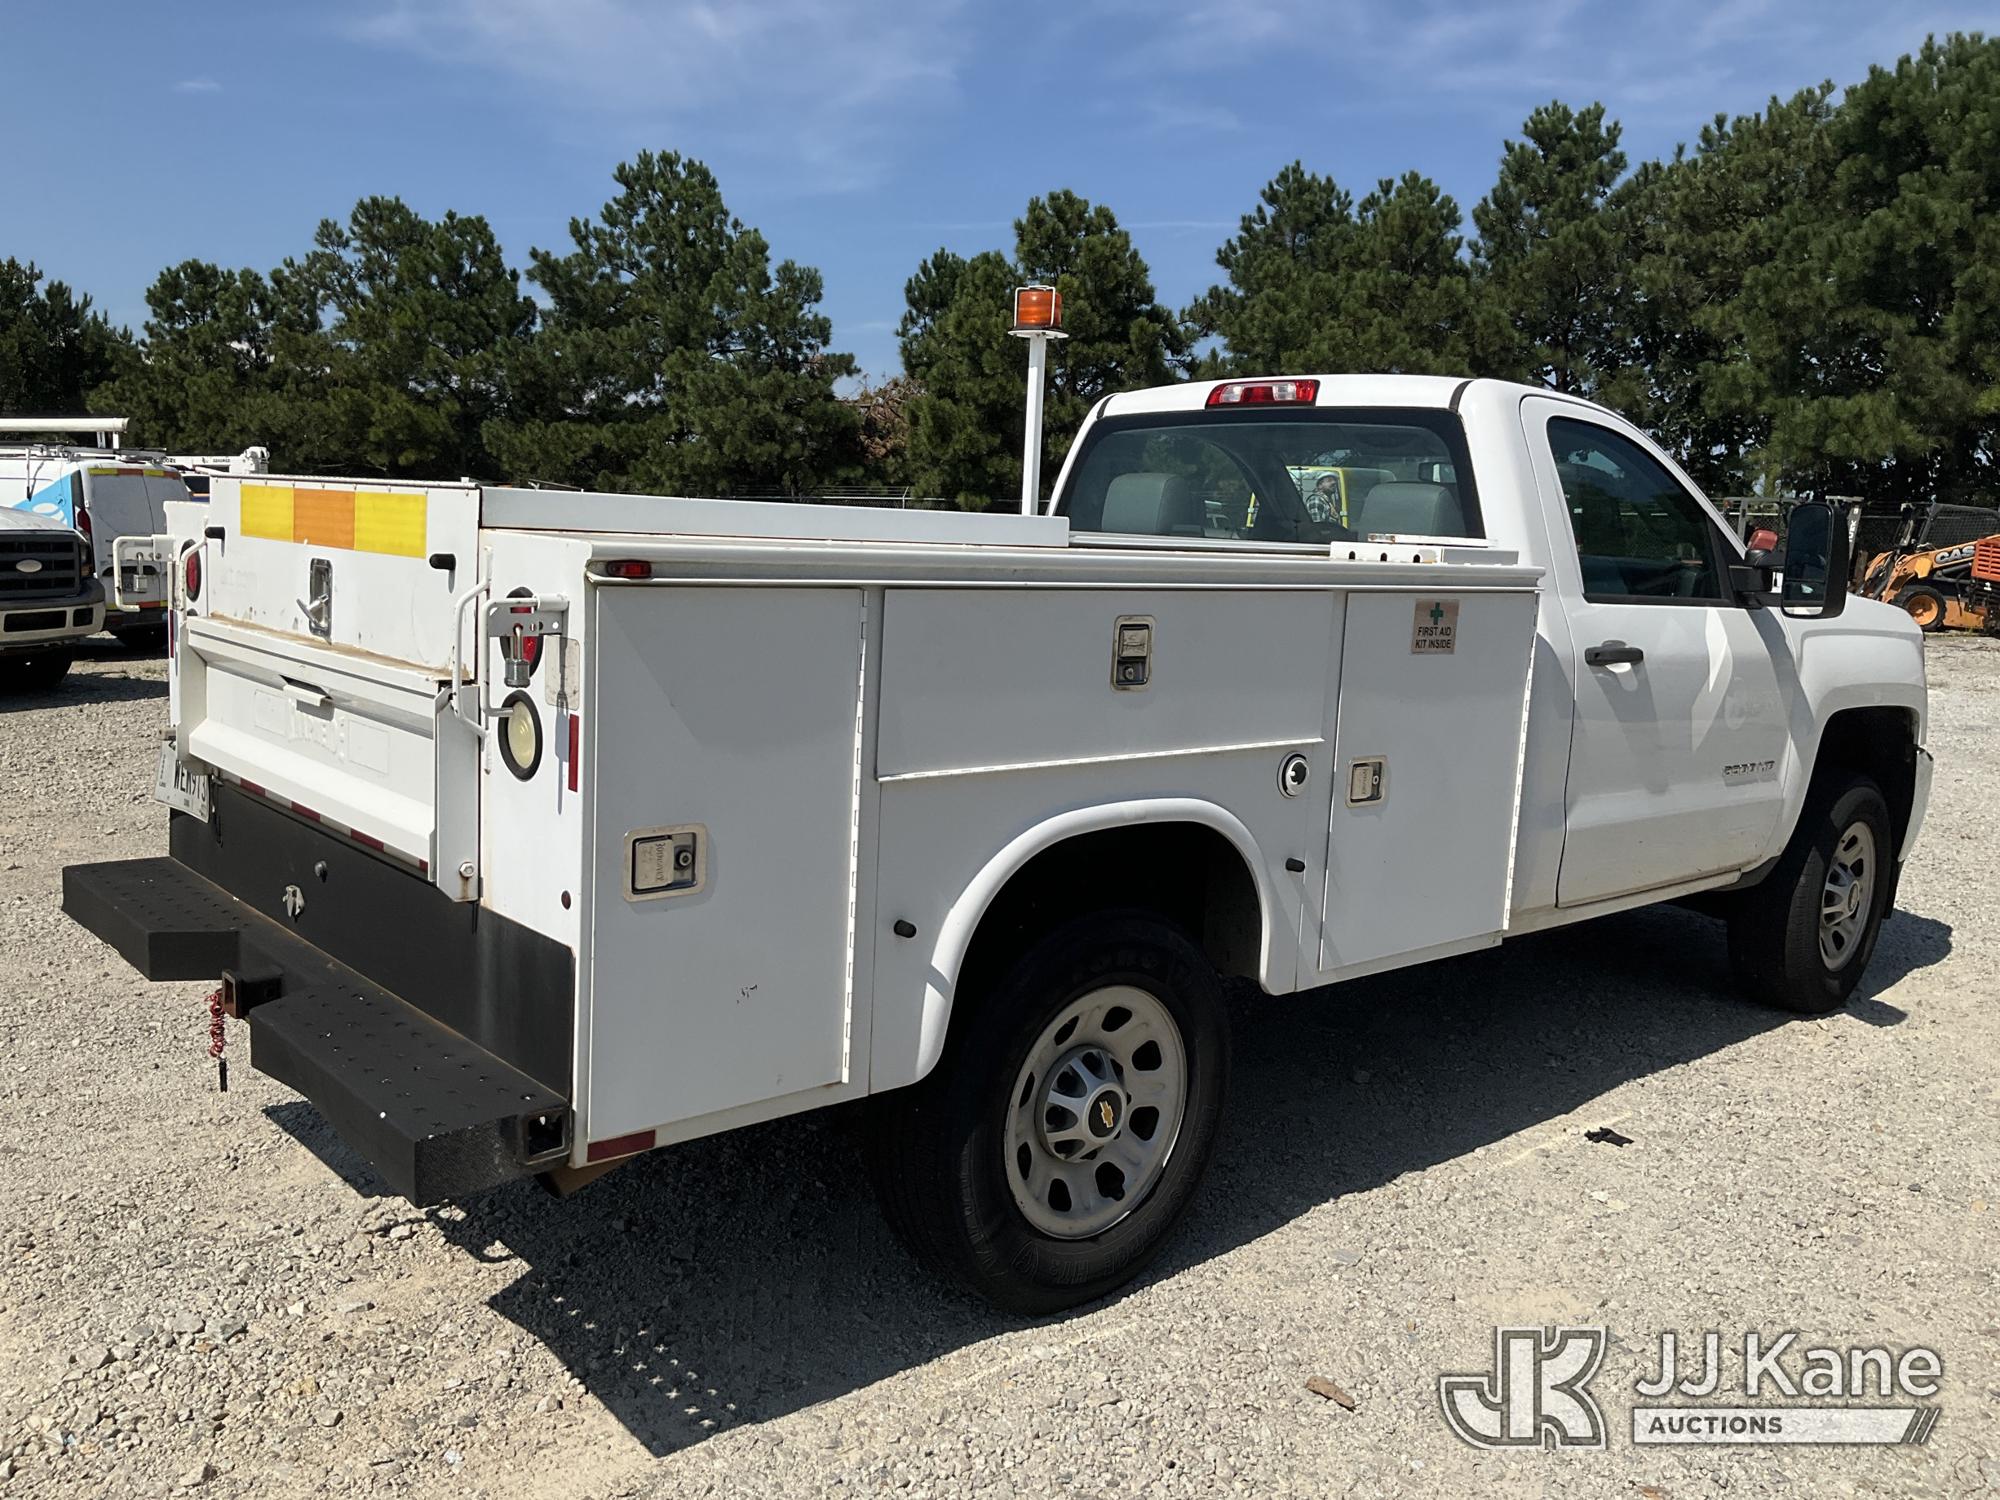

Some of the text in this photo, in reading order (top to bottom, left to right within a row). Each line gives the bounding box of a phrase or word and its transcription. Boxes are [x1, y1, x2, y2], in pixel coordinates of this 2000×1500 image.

[1935, 545, 1976, 564] CAS
[1417, 626, 1452, 636] FIRST AID
[1414, 639, 1452, 649] KIT INSIDE
